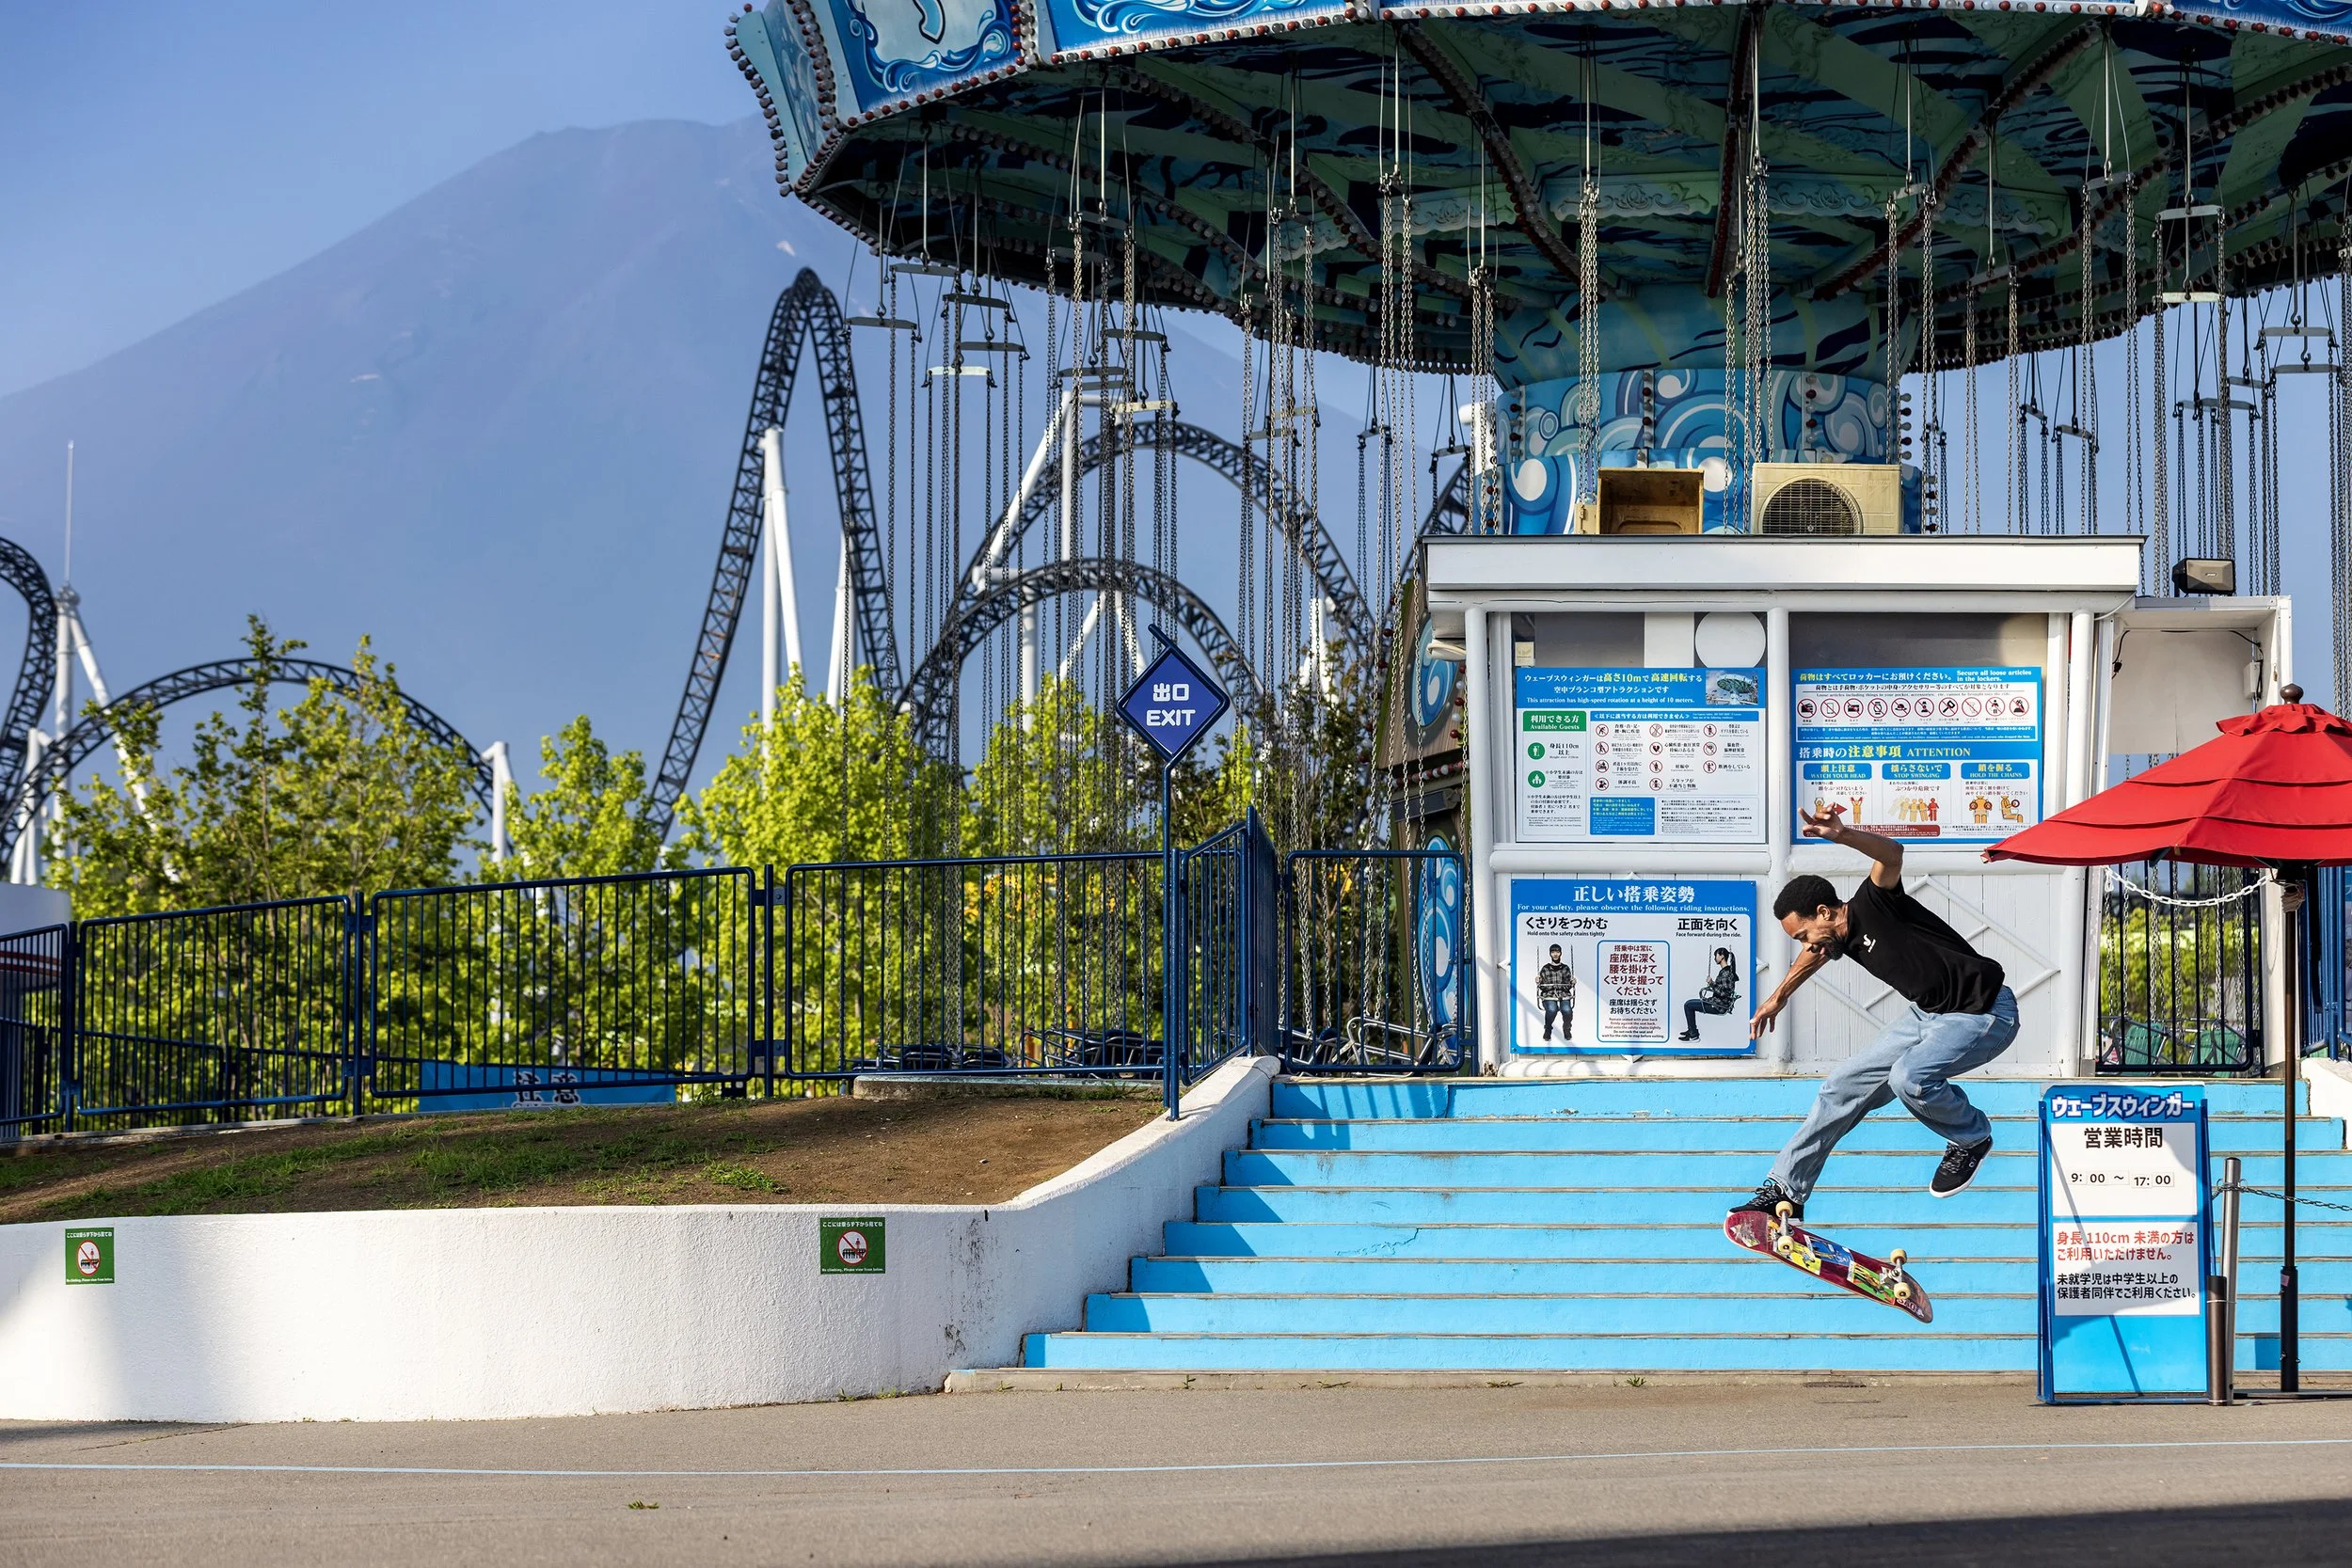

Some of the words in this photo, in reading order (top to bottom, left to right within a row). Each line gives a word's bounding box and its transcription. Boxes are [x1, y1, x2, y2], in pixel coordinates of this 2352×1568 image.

[1800, 673, 1951, 681] 荷物はすべてロッカーにお預けください。
[1153, 683, 1189, 702] 出口
[1554, 686, 1669, 694] 空中ブランコ型アトラクションです
[1147, 709, 1196, 726] EXIT
[1531, 715, 1579, 723] 利用できる方
[1800, 745, 1901, 758] 搭乗時の注意事項
[1907, 748, 1970, 756] ATTENTION
[1891, 764, 1943, 772] 揺らさないで
[1573, 886, 1695, 903] 正しい搭乗姿勢
[1526, 917, 1608, 929] くさりをつかむ
[1677, 918, 1738, 931] 正面を向く
[1610, 954, 1655, 963] 座席に深く
[1610, 964, 1657, 974] 腰を掛けて
[1604, 975, 1663, 985] くさりを握って
[1616, 987, 1651, 995] ください
[2051, 1092, 2194, 1118] ウェーブスウィンガー
[2084, 1128, 2163, 1148] 営業時間
[2058, 1231, 2082, 1244] 身長
[2087, 1232, 2129, 1243] 110cm
[2135, 1230, 2194, 1244] 未満の方は
[2058, 1246, 2171, 1260] ご利用いただけません。
[2058, 1273, 2178, 1285] 未就学児は中学生以上の
[2058, 1287, 2195, 1299] 保護者同伴でご利用ください。
